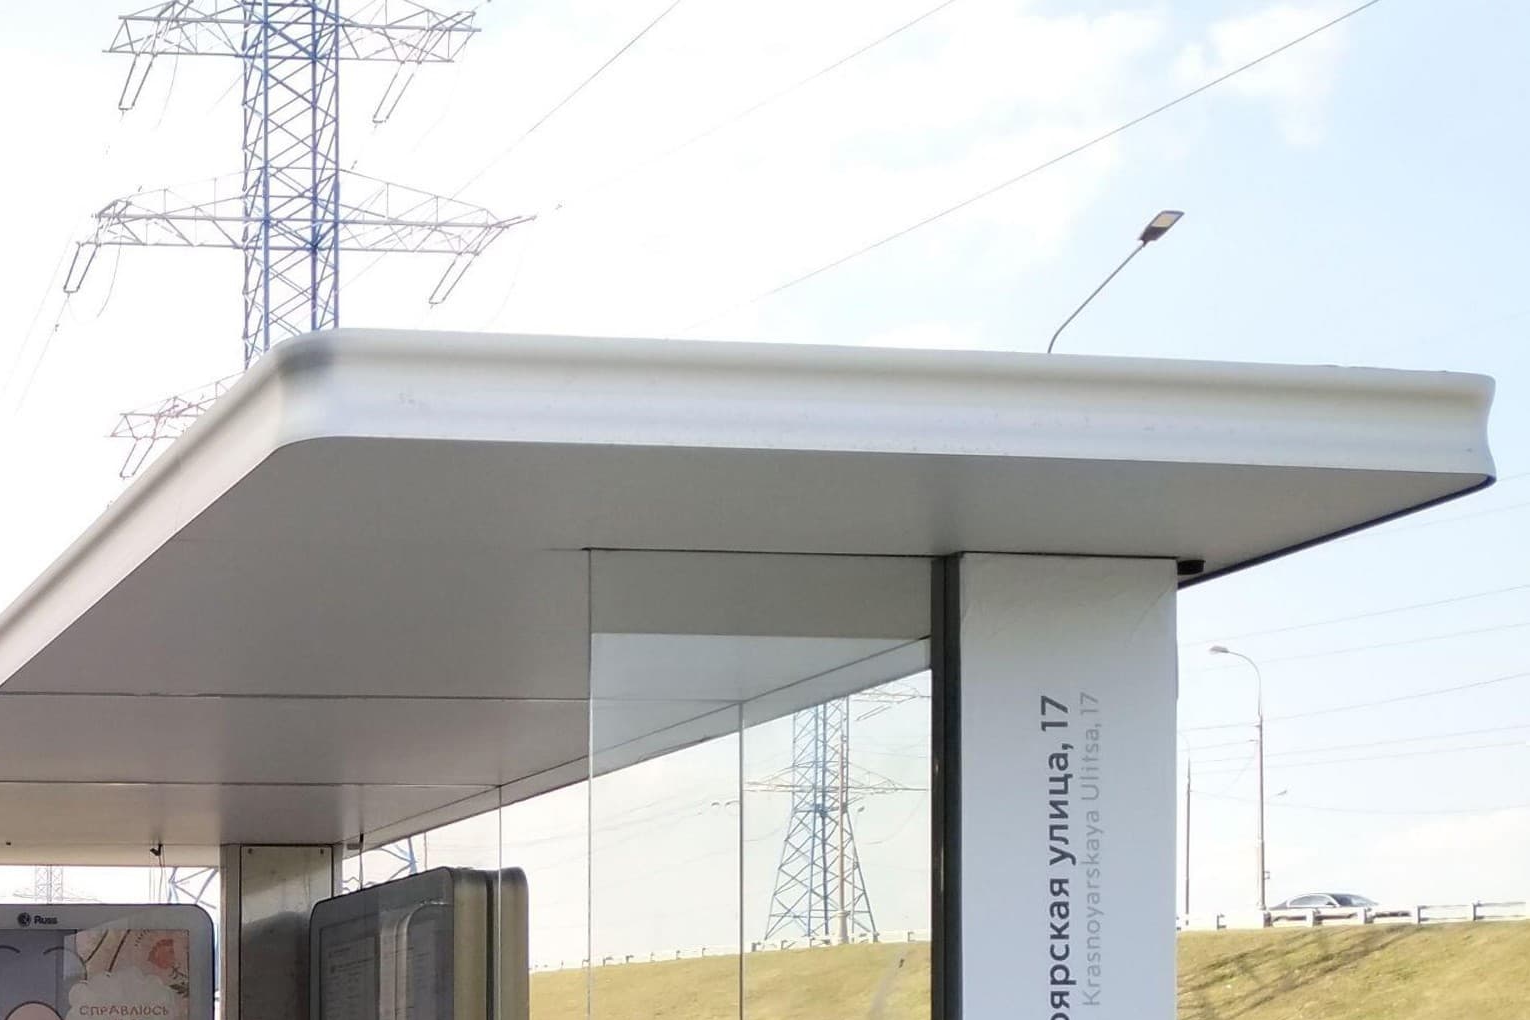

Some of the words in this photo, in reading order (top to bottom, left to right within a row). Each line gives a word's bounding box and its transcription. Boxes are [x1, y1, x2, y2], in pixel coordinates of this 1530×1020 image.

[1041, 696, 1068, 731] 17
[1080, 692, 1099, 715] 17
[1080, 724, 1102, 800] Ulitsa,
[1048, 743, 1077, 866] улица,
[1082, 810, 1104, 1005] Krasnoyarskaya
[79, 1005, 168, 1016] СПРАВЛЮСЬ
